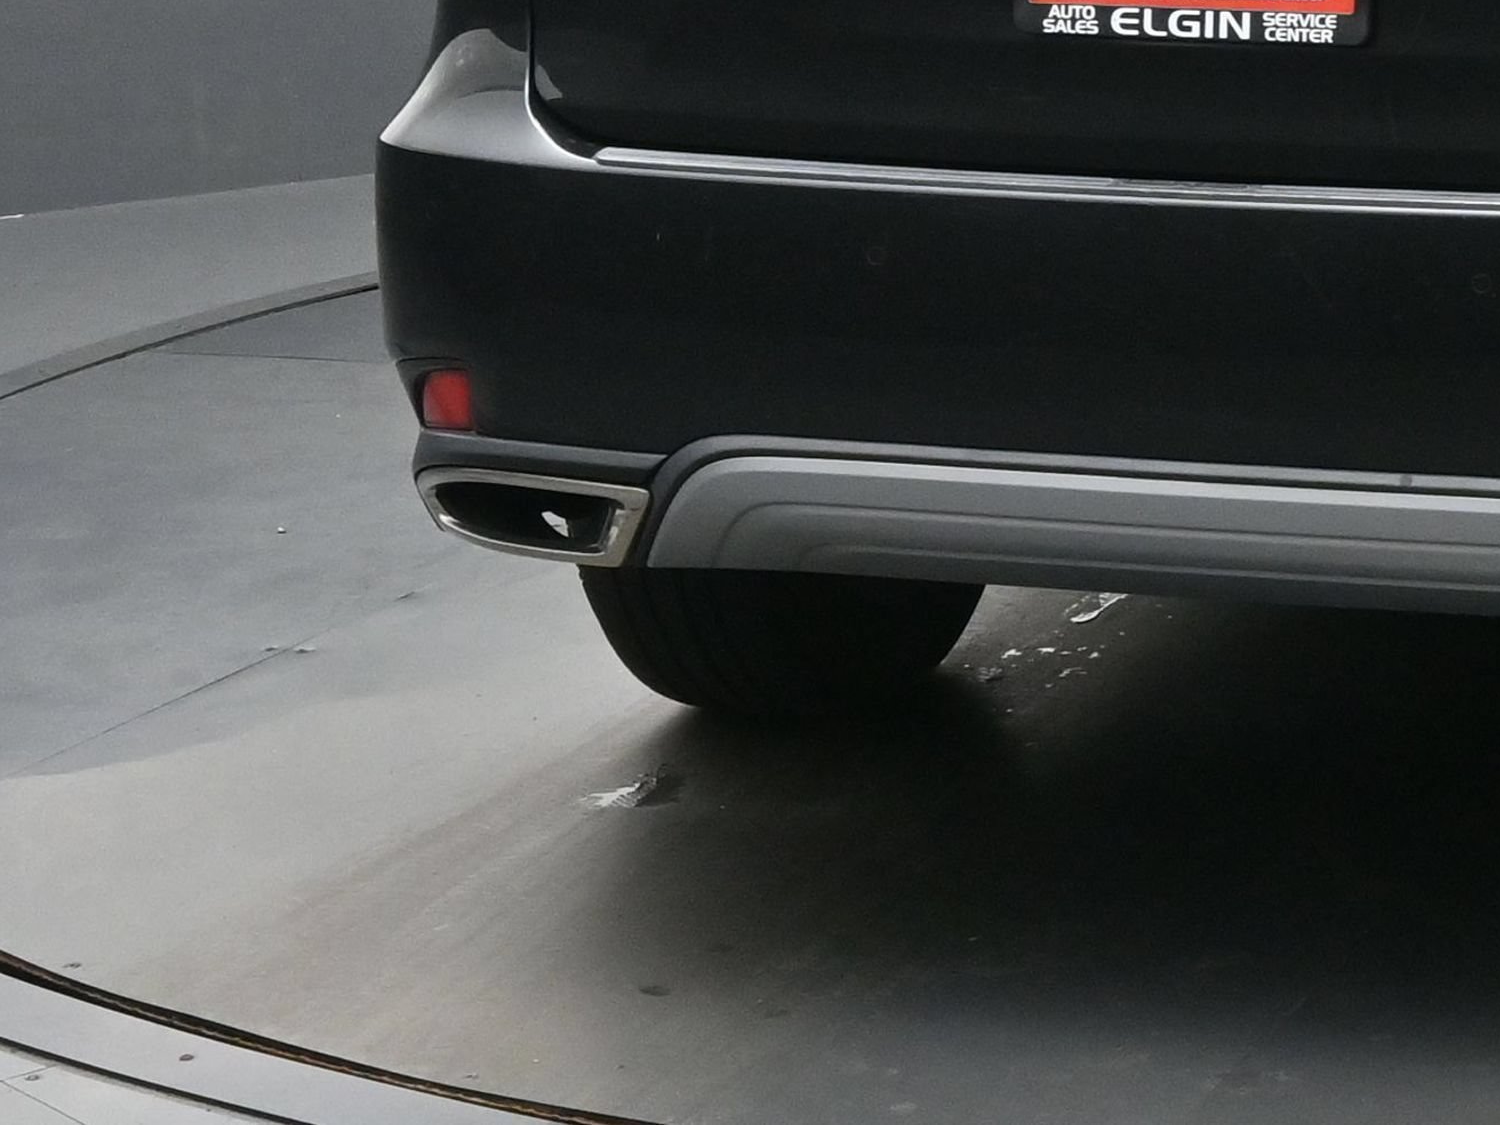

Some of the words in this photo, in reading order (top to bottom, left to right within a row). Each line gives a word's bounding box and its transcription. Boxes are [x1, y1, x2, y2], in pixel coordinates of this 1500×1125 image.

[1048, 5, 1096, 20] AUTO
[1042, 20, 1099, 35] SALES
[1110, 7, 1250, 39] ELGIN
[1262, 13, 1337, 29] SERVICE
[1264, 28, 1333, 43] CENTER
